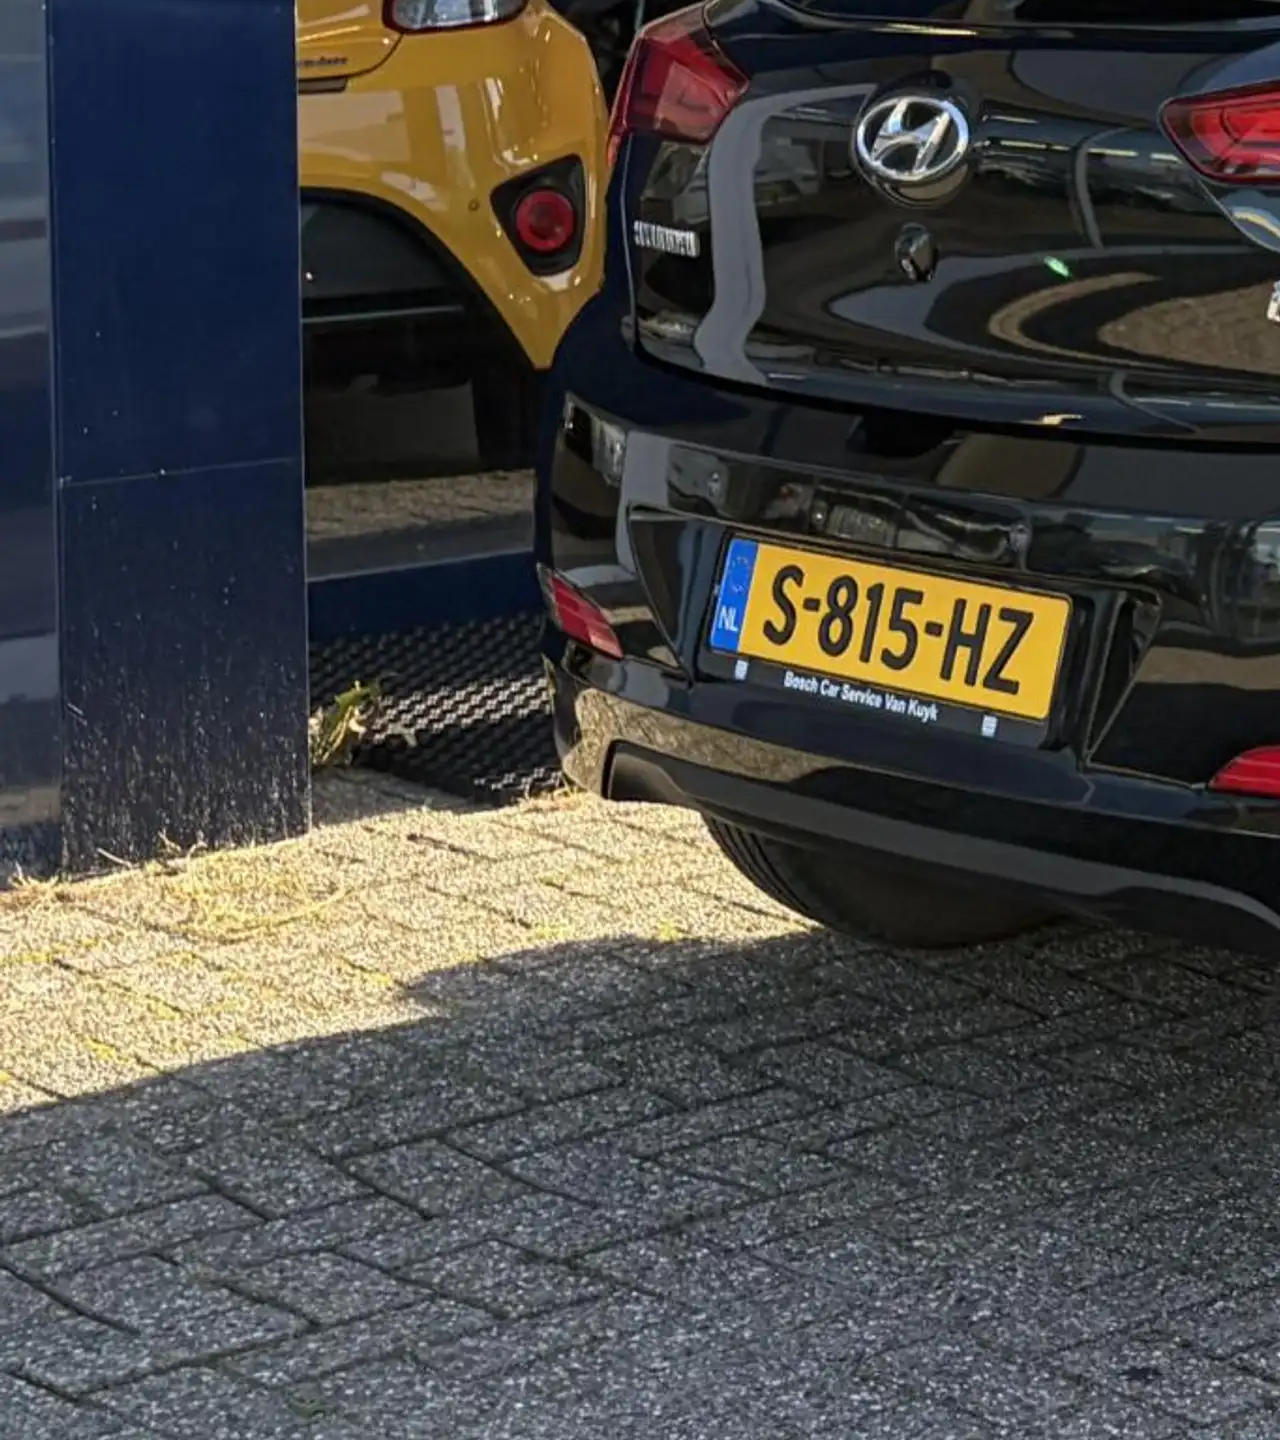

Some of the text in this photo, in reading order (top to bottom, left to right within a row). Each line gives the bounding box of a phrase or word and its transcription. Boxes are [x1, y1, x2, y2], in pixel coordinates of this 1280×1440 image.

[718, 606, 738, 631] NL
[762, 564, 1035, 695] S-815-HZ
[783, 670, 939, 723] Bosch Car Service Van Kuyk
